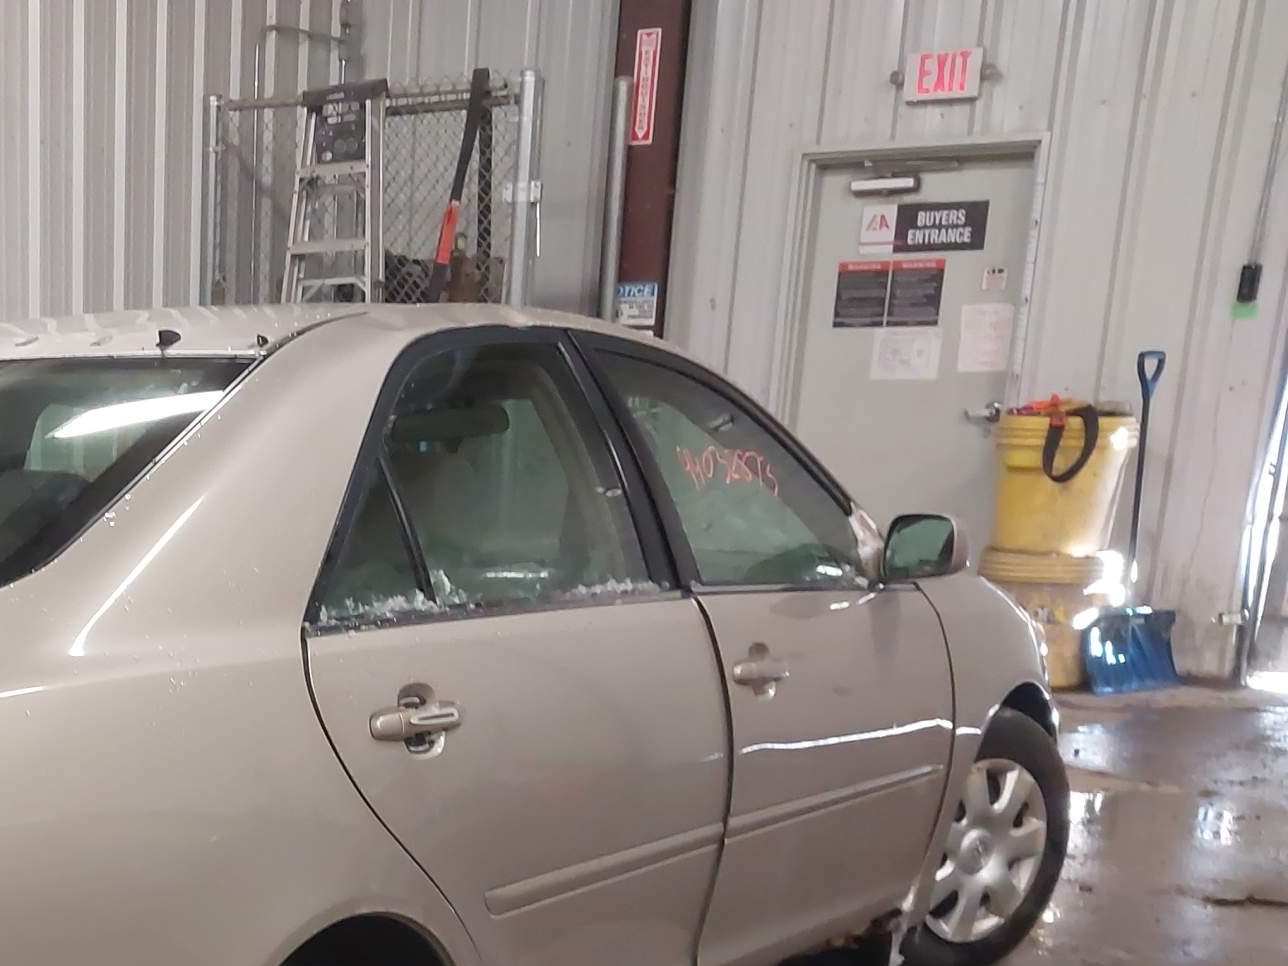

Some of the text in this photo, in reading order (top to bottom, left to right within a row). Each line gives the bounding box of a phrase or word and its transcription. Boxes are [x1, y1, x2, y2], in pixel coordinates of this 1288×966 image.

[917, 51, 970, 94] EXIT
[917, 208, 966, 227] BUYERS
[907, 226, 972, 245] ENTRANCE
